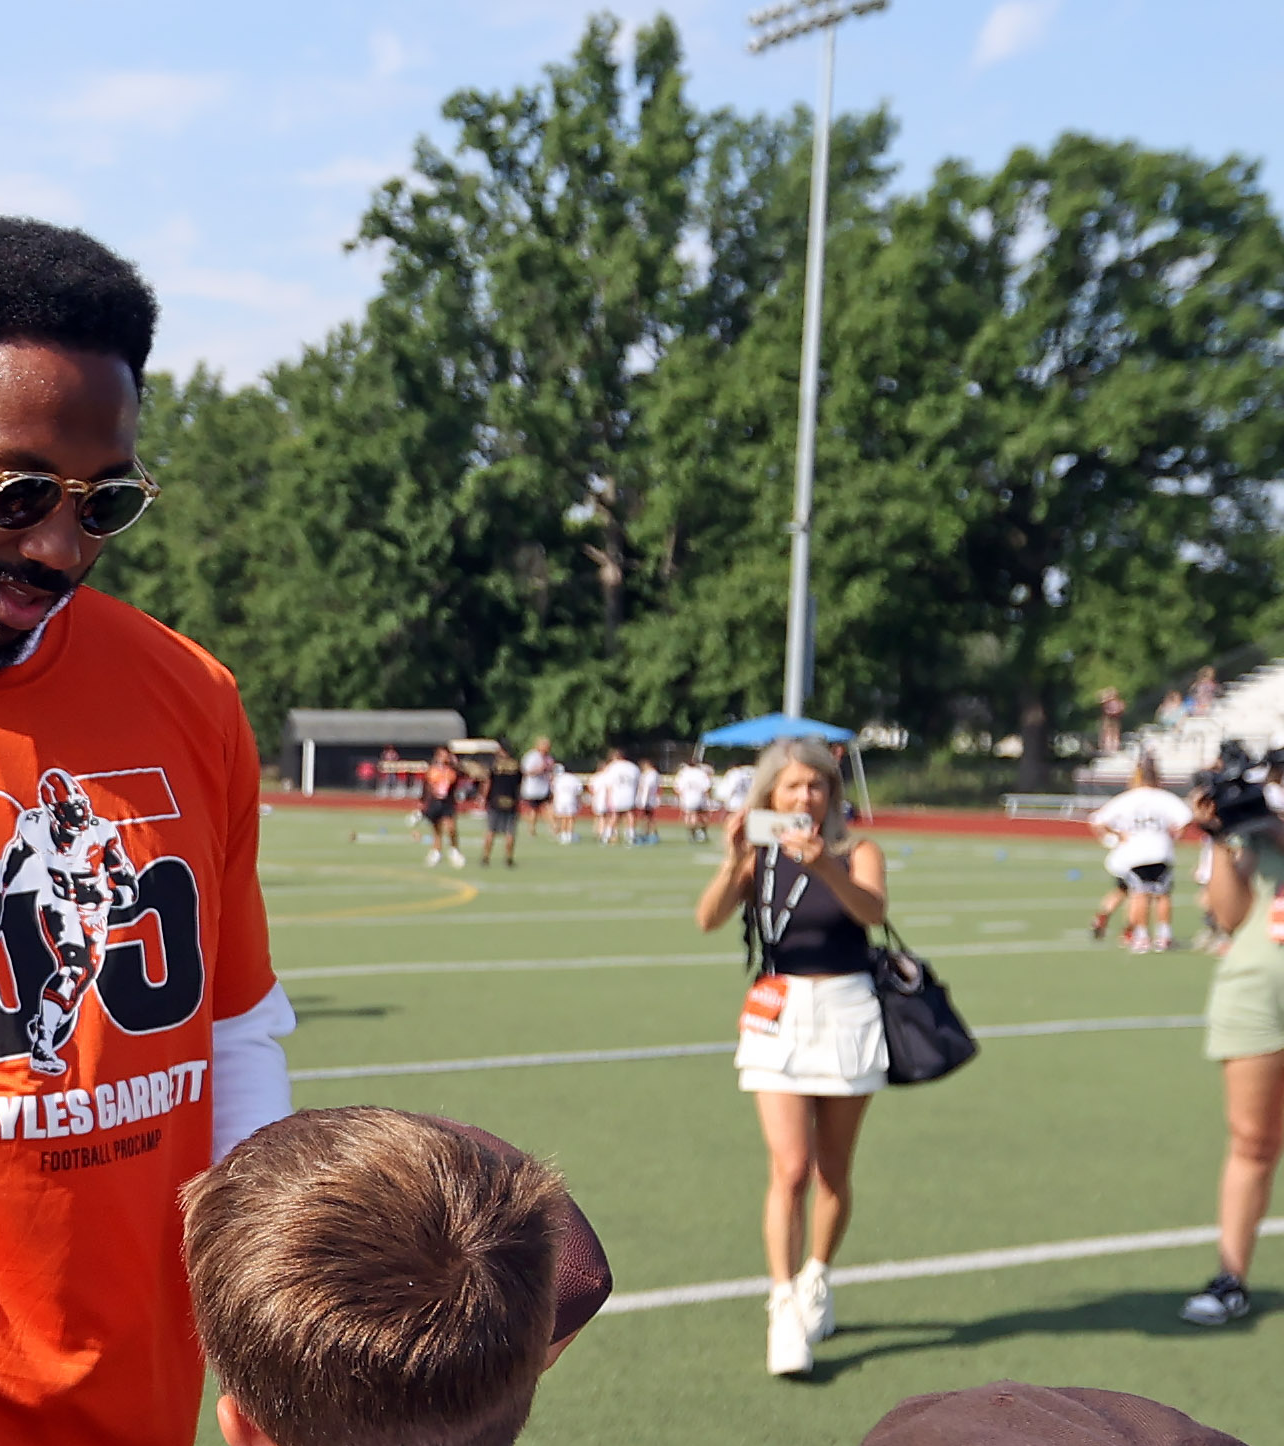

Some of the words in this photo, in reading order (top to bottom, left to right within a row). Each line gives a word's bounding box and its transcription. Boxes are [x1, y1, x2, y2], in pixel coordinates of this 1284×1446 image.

[95, 1060, 208, 1130] GARRETT
[41, 1140, 112, 1172] FOOTBALL
[115, 1129, 162, 1161] PROCAMP
